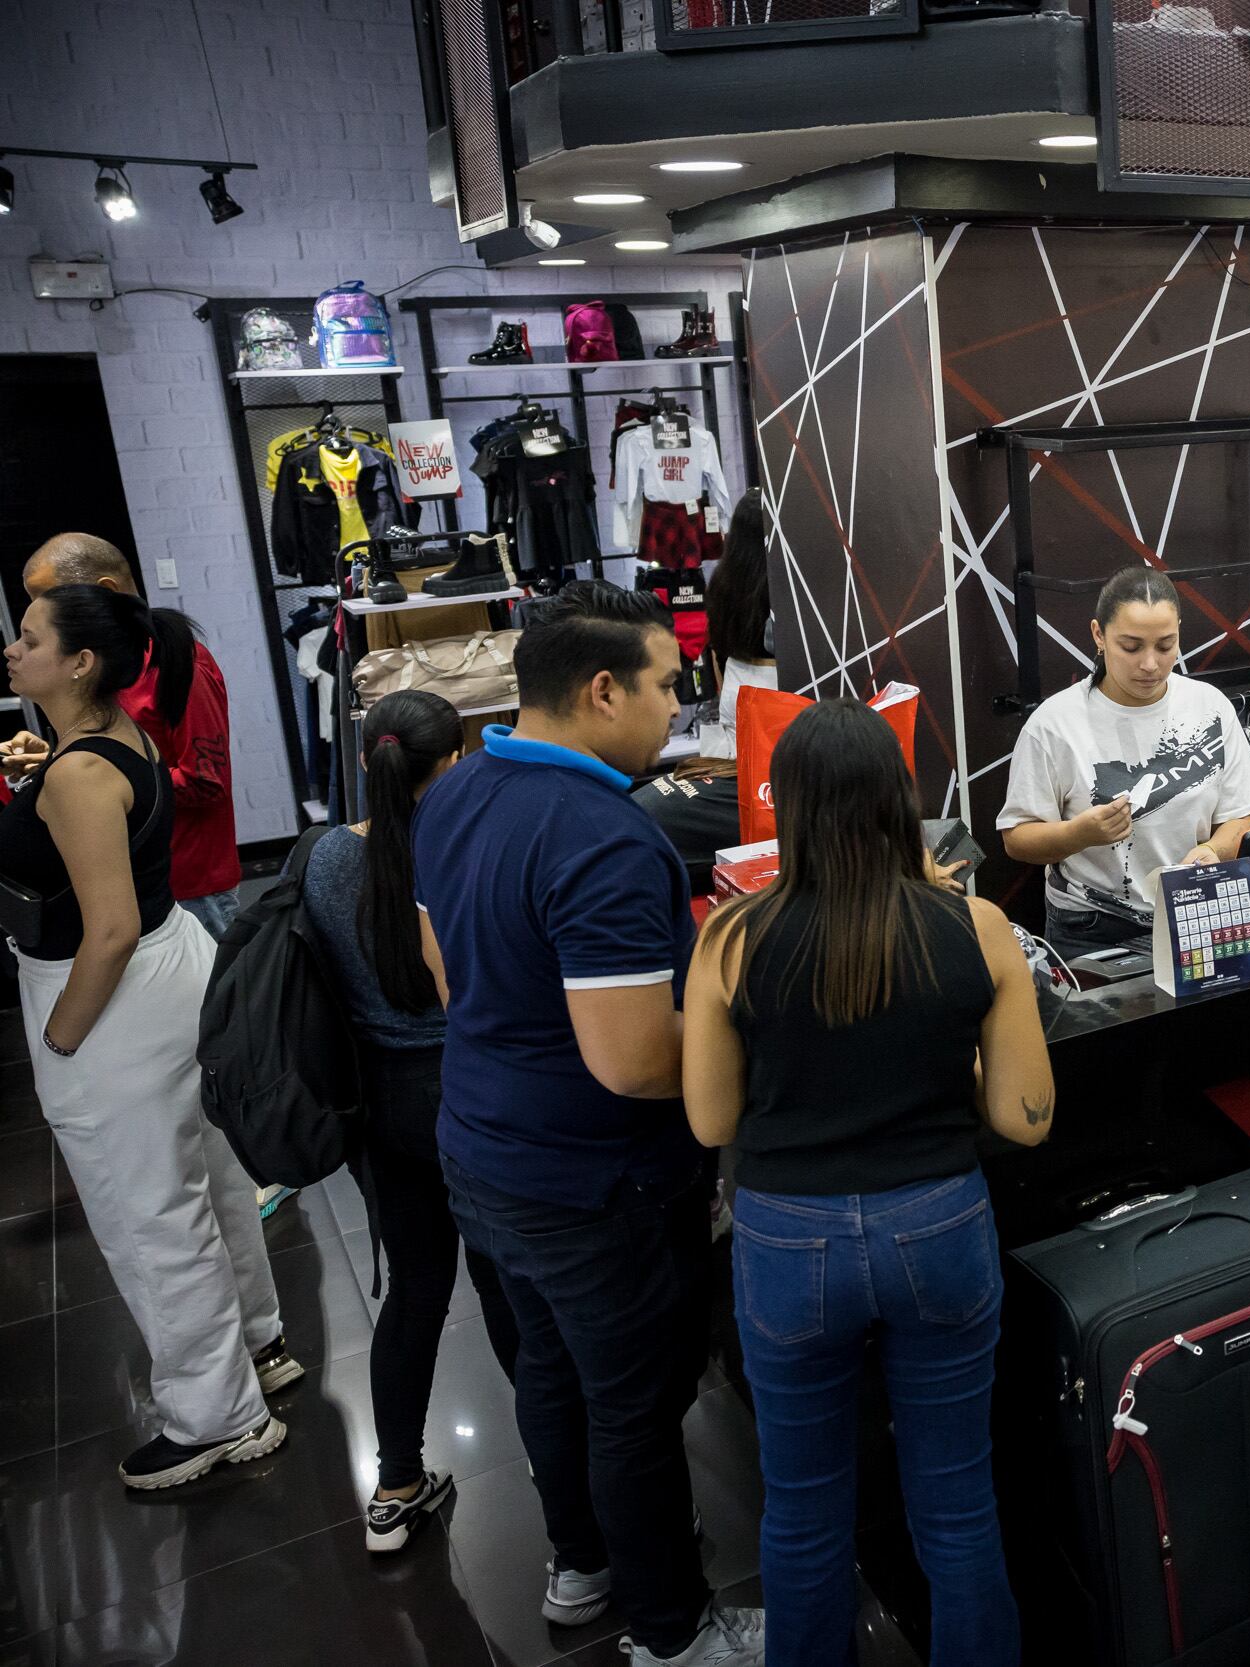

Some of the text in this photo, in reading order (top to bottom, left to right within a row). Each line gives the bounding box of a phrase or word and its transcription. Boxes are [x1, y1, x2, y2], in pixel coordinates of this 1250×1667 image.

[398, 439, 445, 472] NEW
[402, 456, 452, 471] COLLECTION
[657, 456, 690, 469] JUMP
[663, 468, 685, 481] GIRL
[679, 585, 694, 596] NEW
[672, 594, 704, 605] COLLECTION
[1112, 735, 1225, 800] UMP
